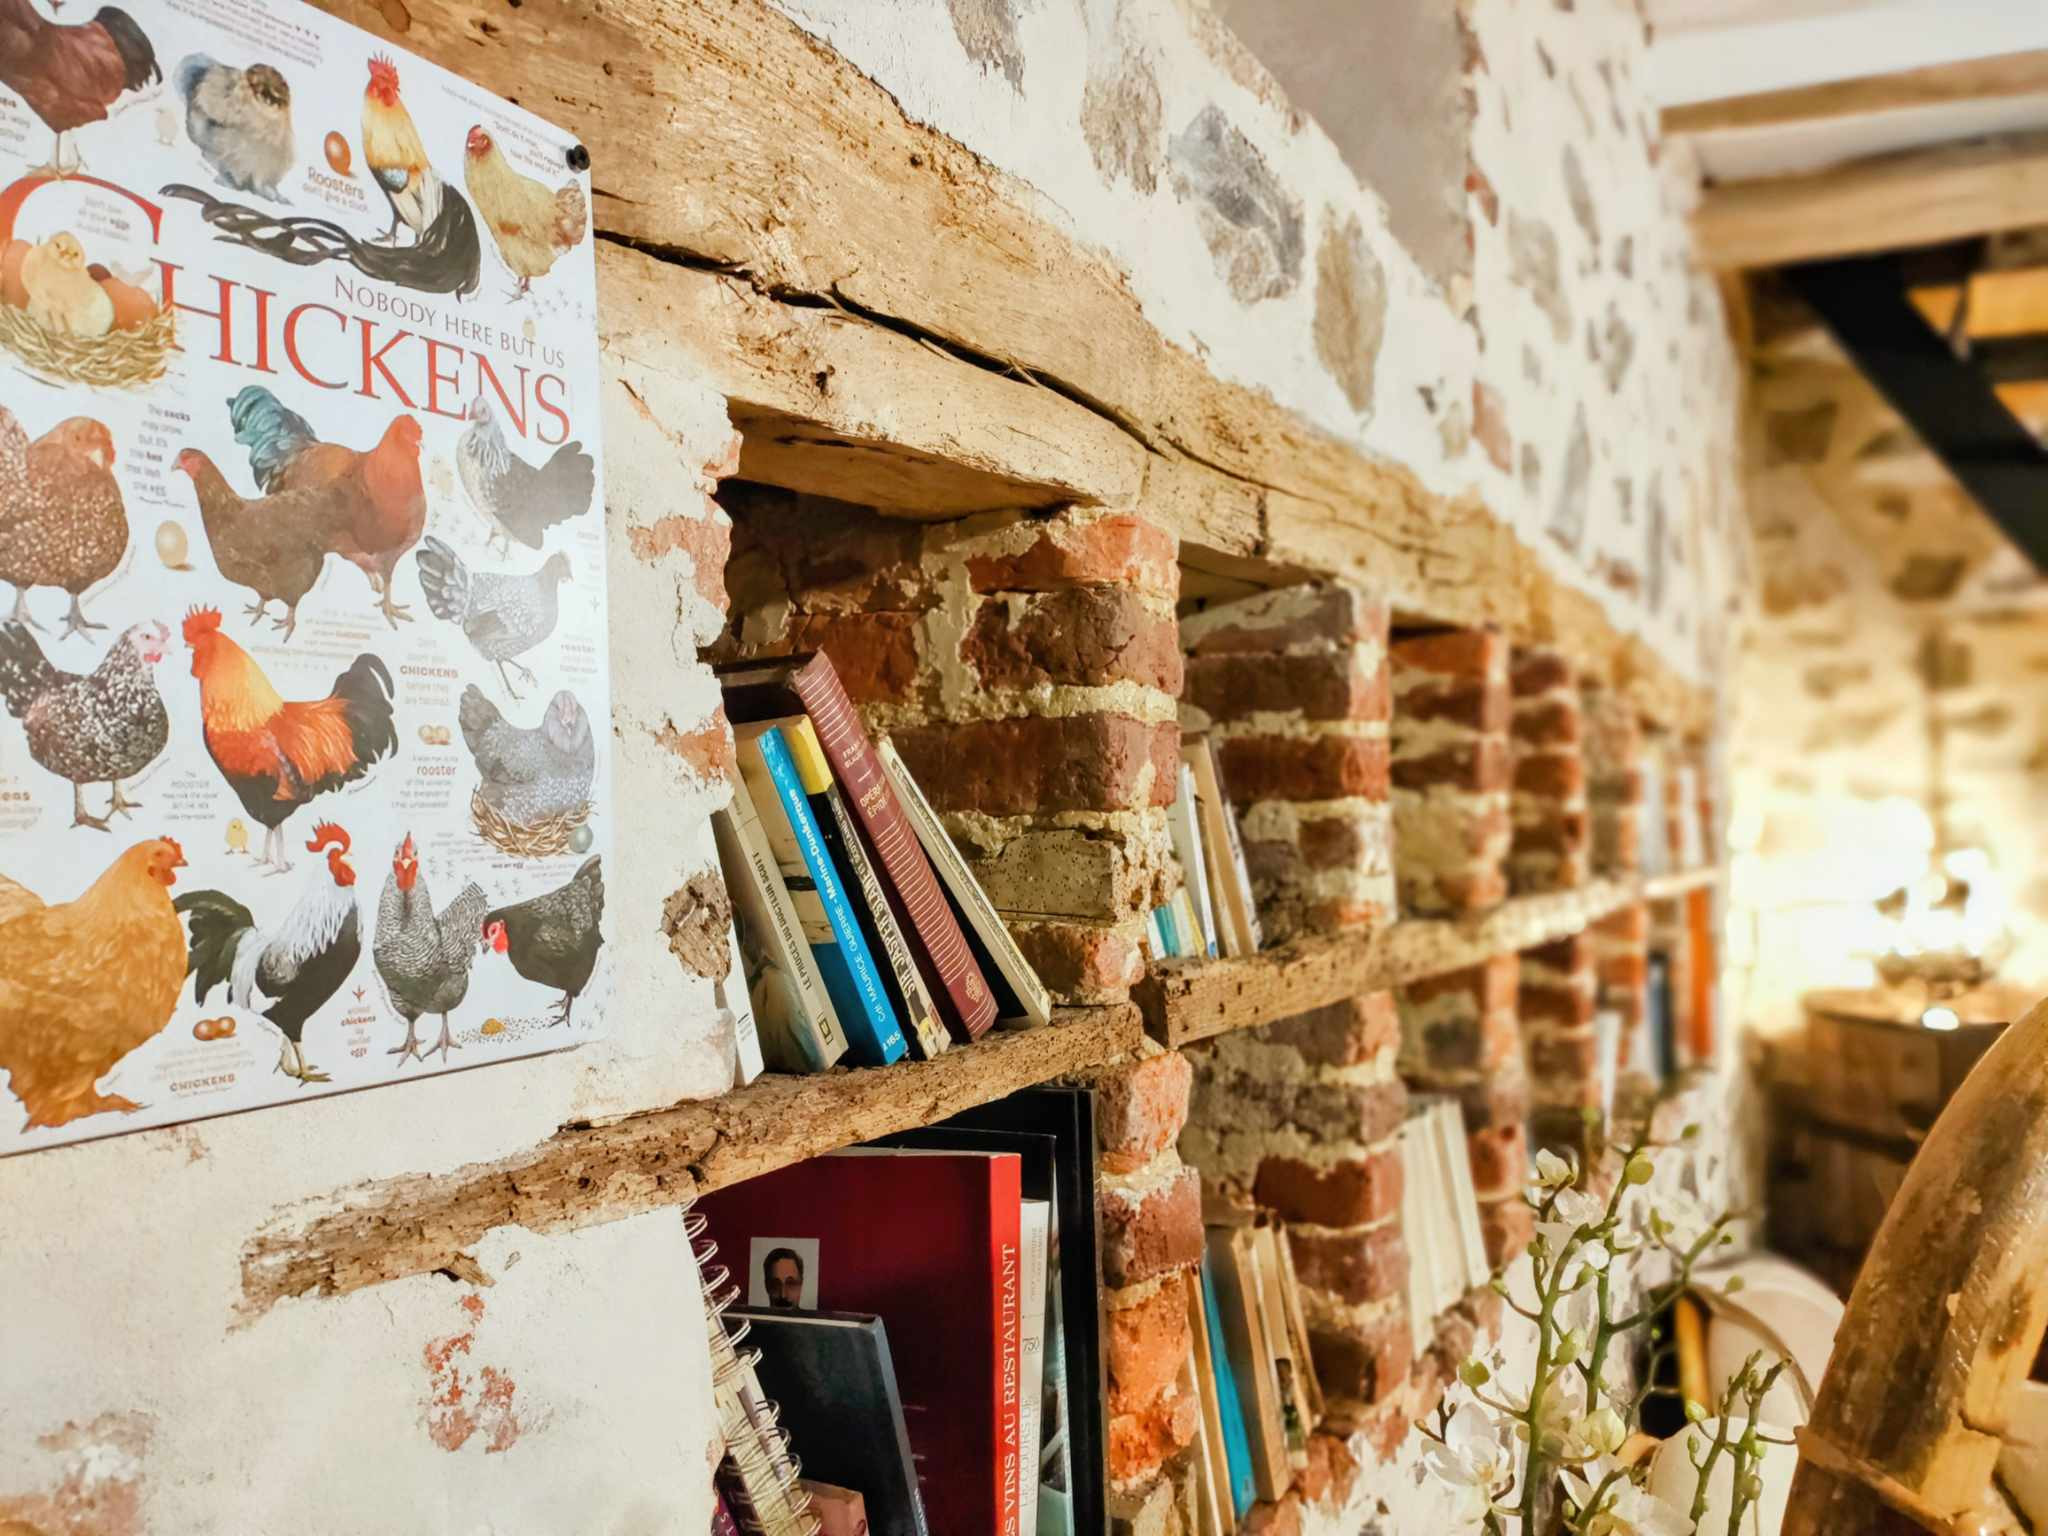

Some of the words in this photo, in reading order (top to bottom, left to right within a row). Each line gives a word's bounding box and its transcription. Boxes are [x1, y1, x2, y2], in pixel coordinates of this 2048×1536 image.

[334, 275, 437, 327] NOBODY
[445, 314, 493, 346] HERE
[500, 332, 536, 359] BUT
[543, 347, 566, 369] US
[853, 953, 881, 1000] MAURICE
[1002, 1243, 1015, 1405] RESTAURANT
[1003, 1413, 1015, 1444] AU
[1004, 1452, 1015, 1513] VINS
